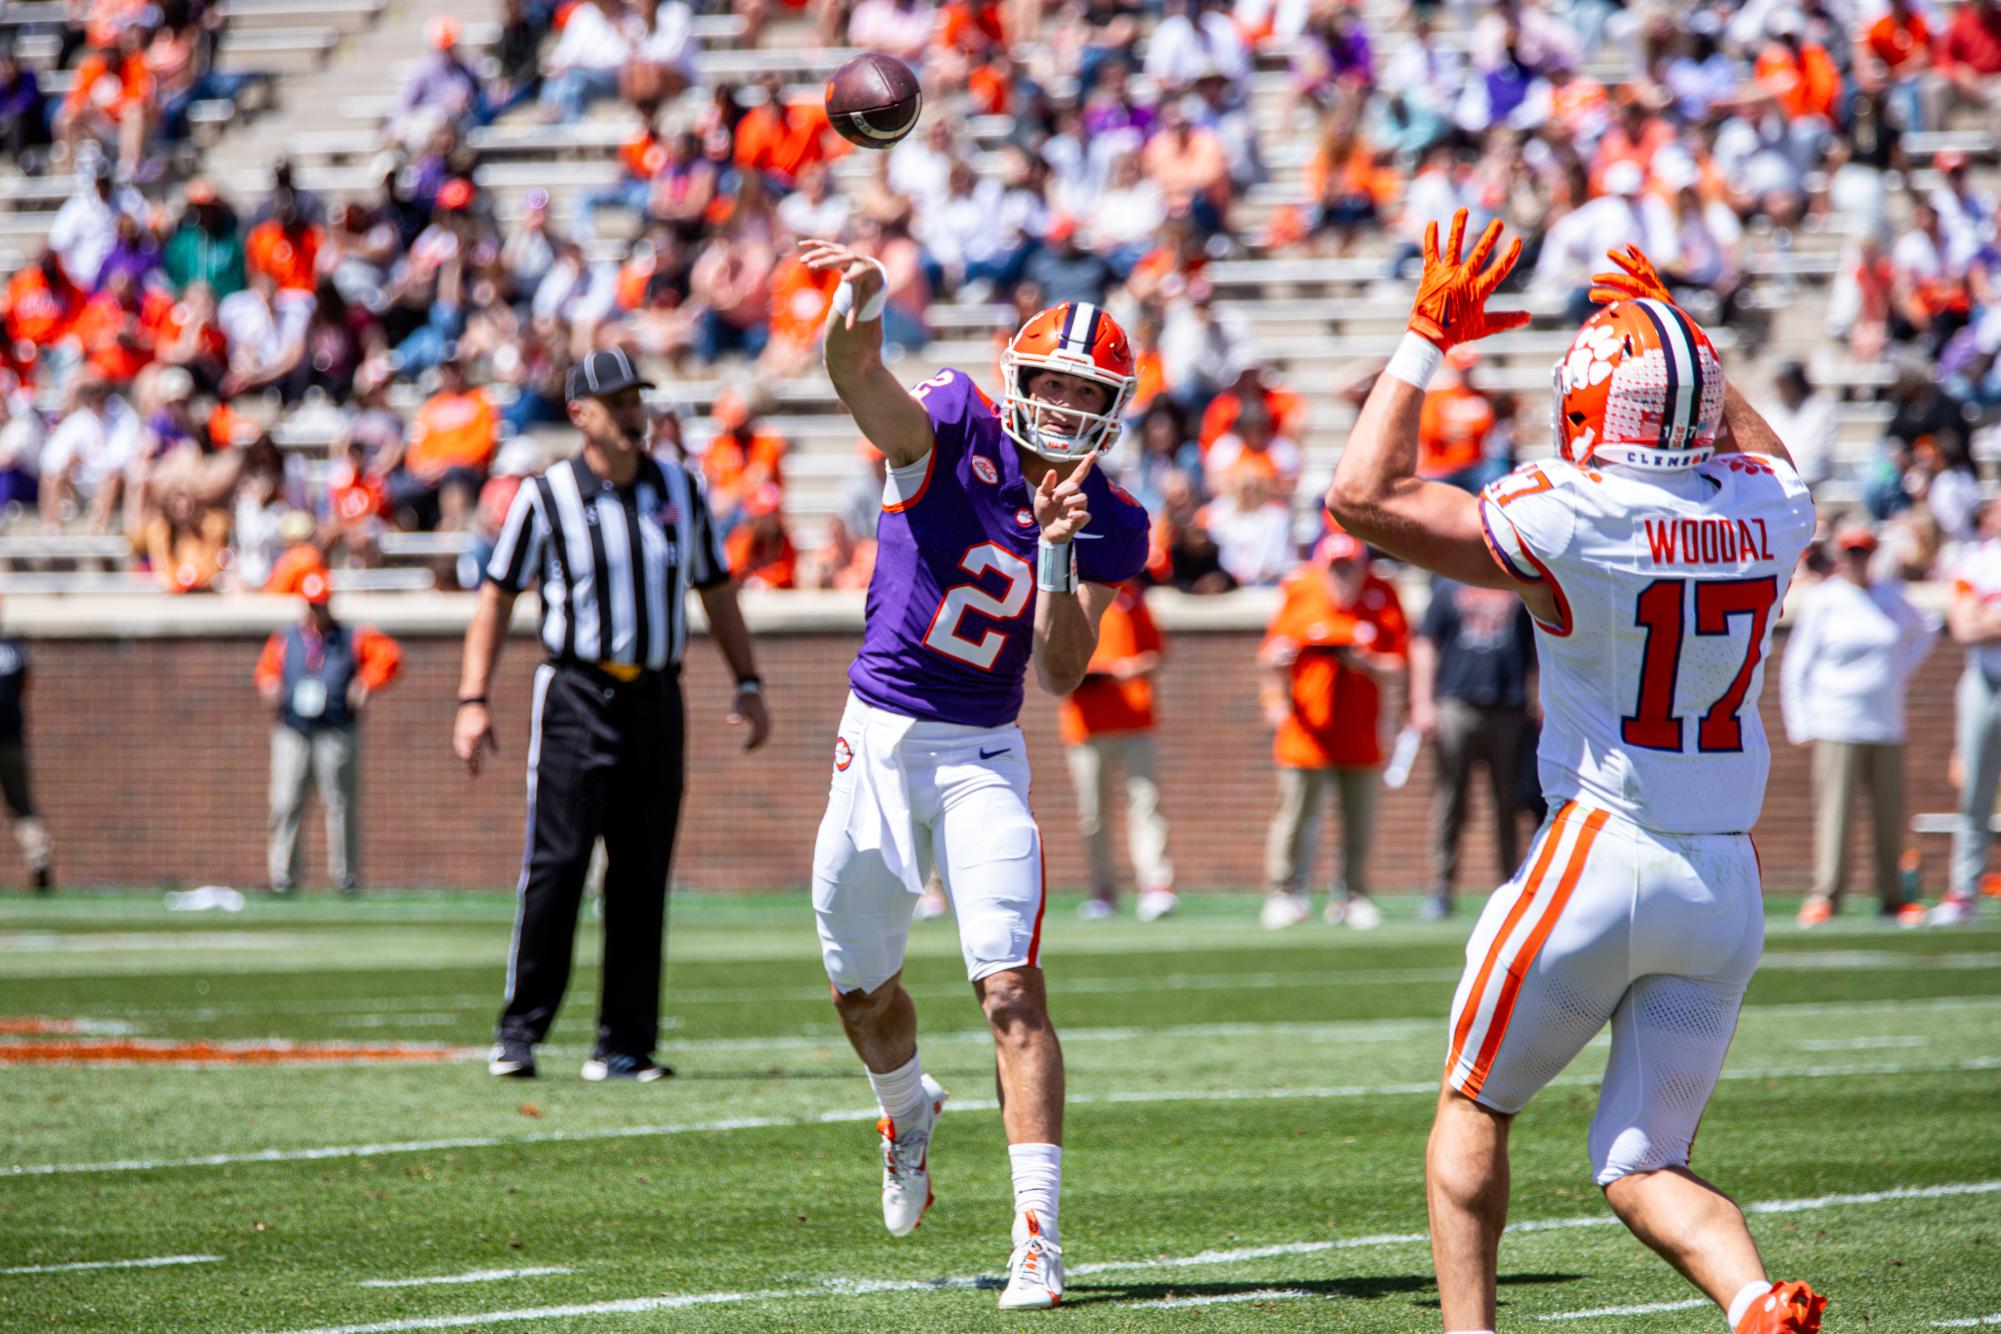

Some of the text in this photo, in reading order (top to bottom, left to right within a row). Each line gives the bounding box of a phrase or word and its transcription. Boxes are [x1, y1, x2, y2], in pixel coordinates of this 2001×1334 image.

[921, 540, 1037, 672] 2
[1644, 518, 1775, 565] WOODAZ
[1620, 574, 1778, 753] 17
